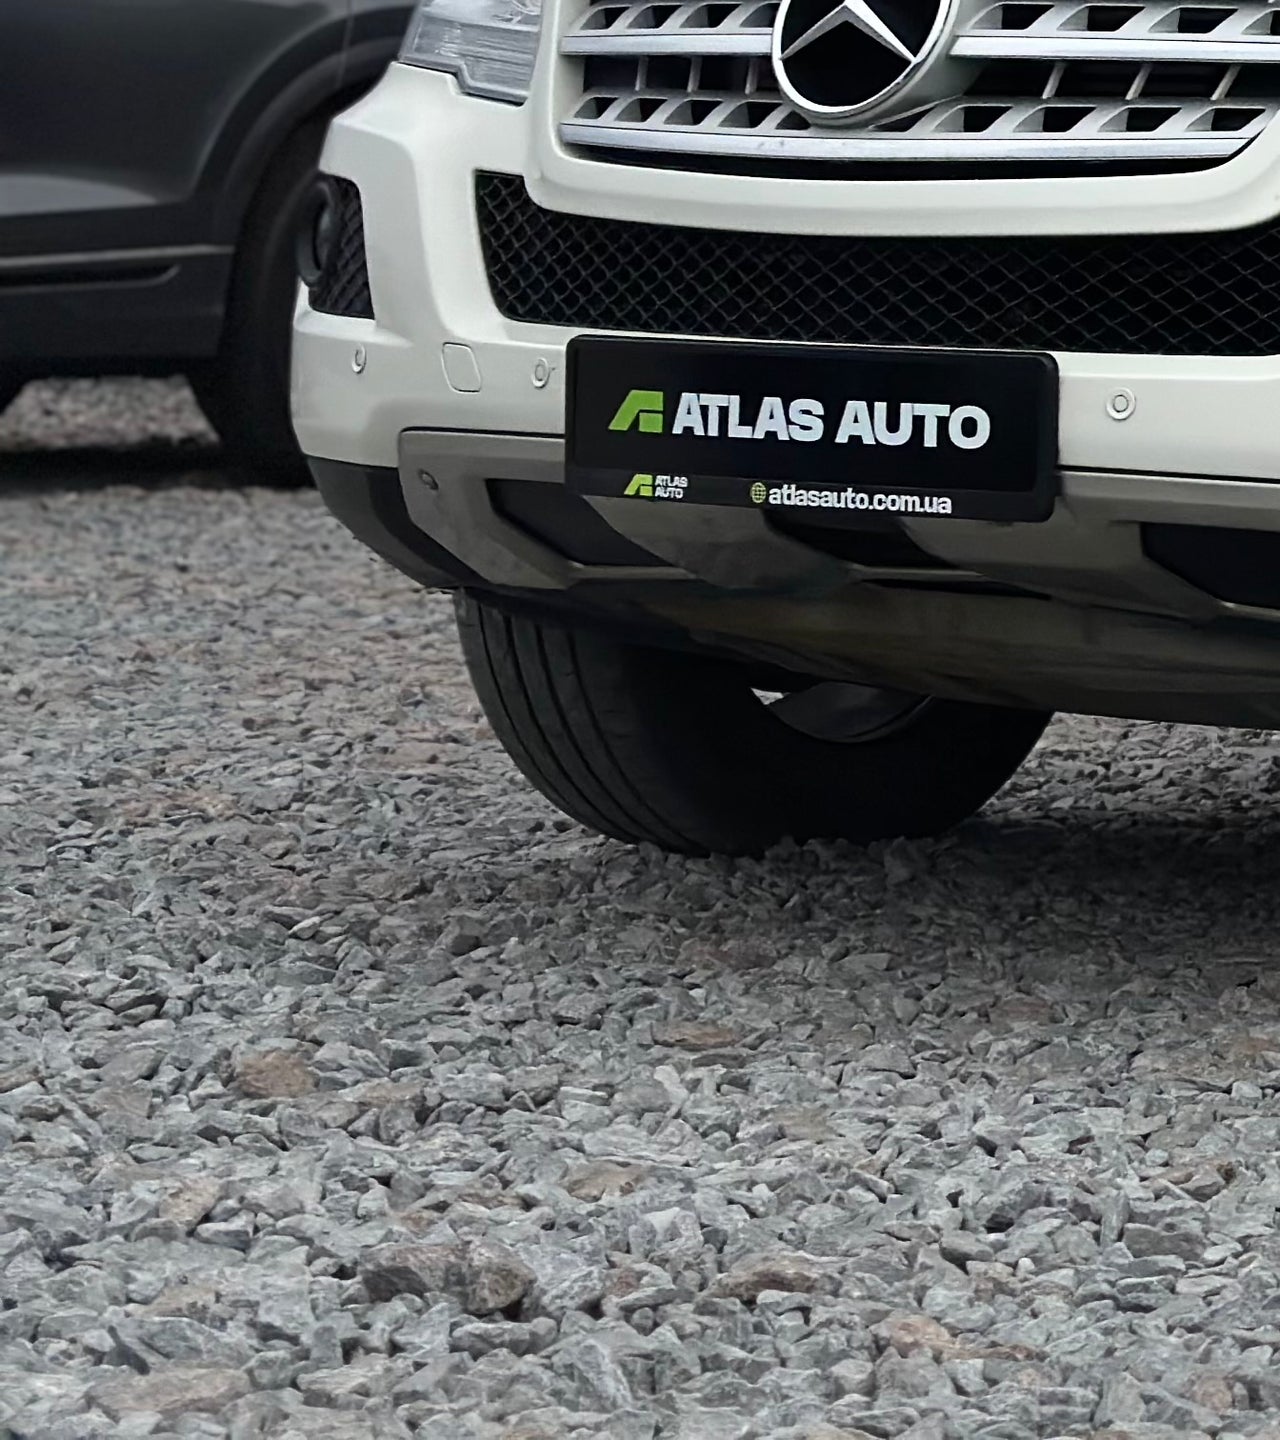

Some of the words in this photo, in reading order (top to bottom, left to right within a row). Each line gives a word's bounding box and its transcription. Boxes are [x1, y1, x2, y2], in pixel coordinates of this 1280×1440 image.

[672, 391, 825, 443] ATLAS
[834, 400, 991, 450] AUTO
[655, 474, 689, 488] ATLAS
[654, 486, 684, 499] AUTO
[768, 484, 952, 514] atlasauto.com.ua
